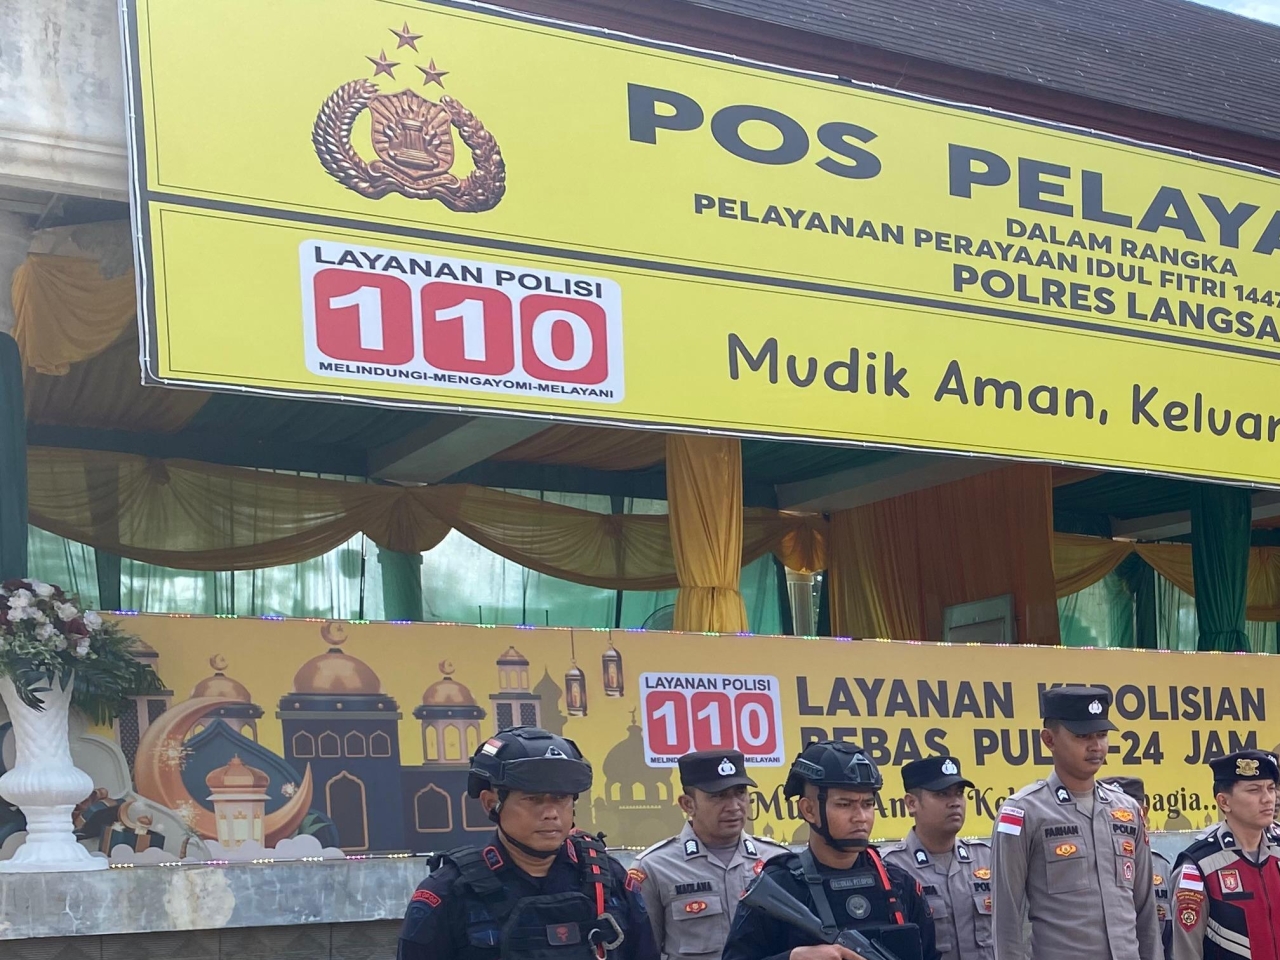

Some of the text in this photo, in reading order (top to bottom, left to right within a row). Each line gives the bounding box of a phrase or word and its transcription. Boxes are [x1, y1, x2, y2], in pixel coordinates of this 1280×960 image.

[627, 82, 882, 179] POS
[694, 193, 904, 245] PELAYANAN
[914, 228, 1077, 273] PERAYAAN
[1087, 257, 1152, 286] IDUL
[1160, 270, 1226, 298] FITRI
[1006, 217, 1238, 277] DALAM RANGKA
[314, 246, 602, 299] LAYANAN POLISI
[329, 285, 594, 371] 110
[953, 263, 1280, 342] POLRES LANGSA
[319, 361, 614, 398] MELINDUNGI-MENGAYOMI-MELAYANI
[728, 332, 910, 398] Mudik
[934, 360, 1108, 426] Aman,
[645, 677, 771, 691] LAYANAN POLISI
[796, 676, 1266, 721] LAYANAN OLISIAN
[653, 700, 769, 746] 110
[974, 730, 1164, 765] PUL-24
[1184, 730, 1258, 765] JAM
[1044, 825, 1079, 838] FARHAN
